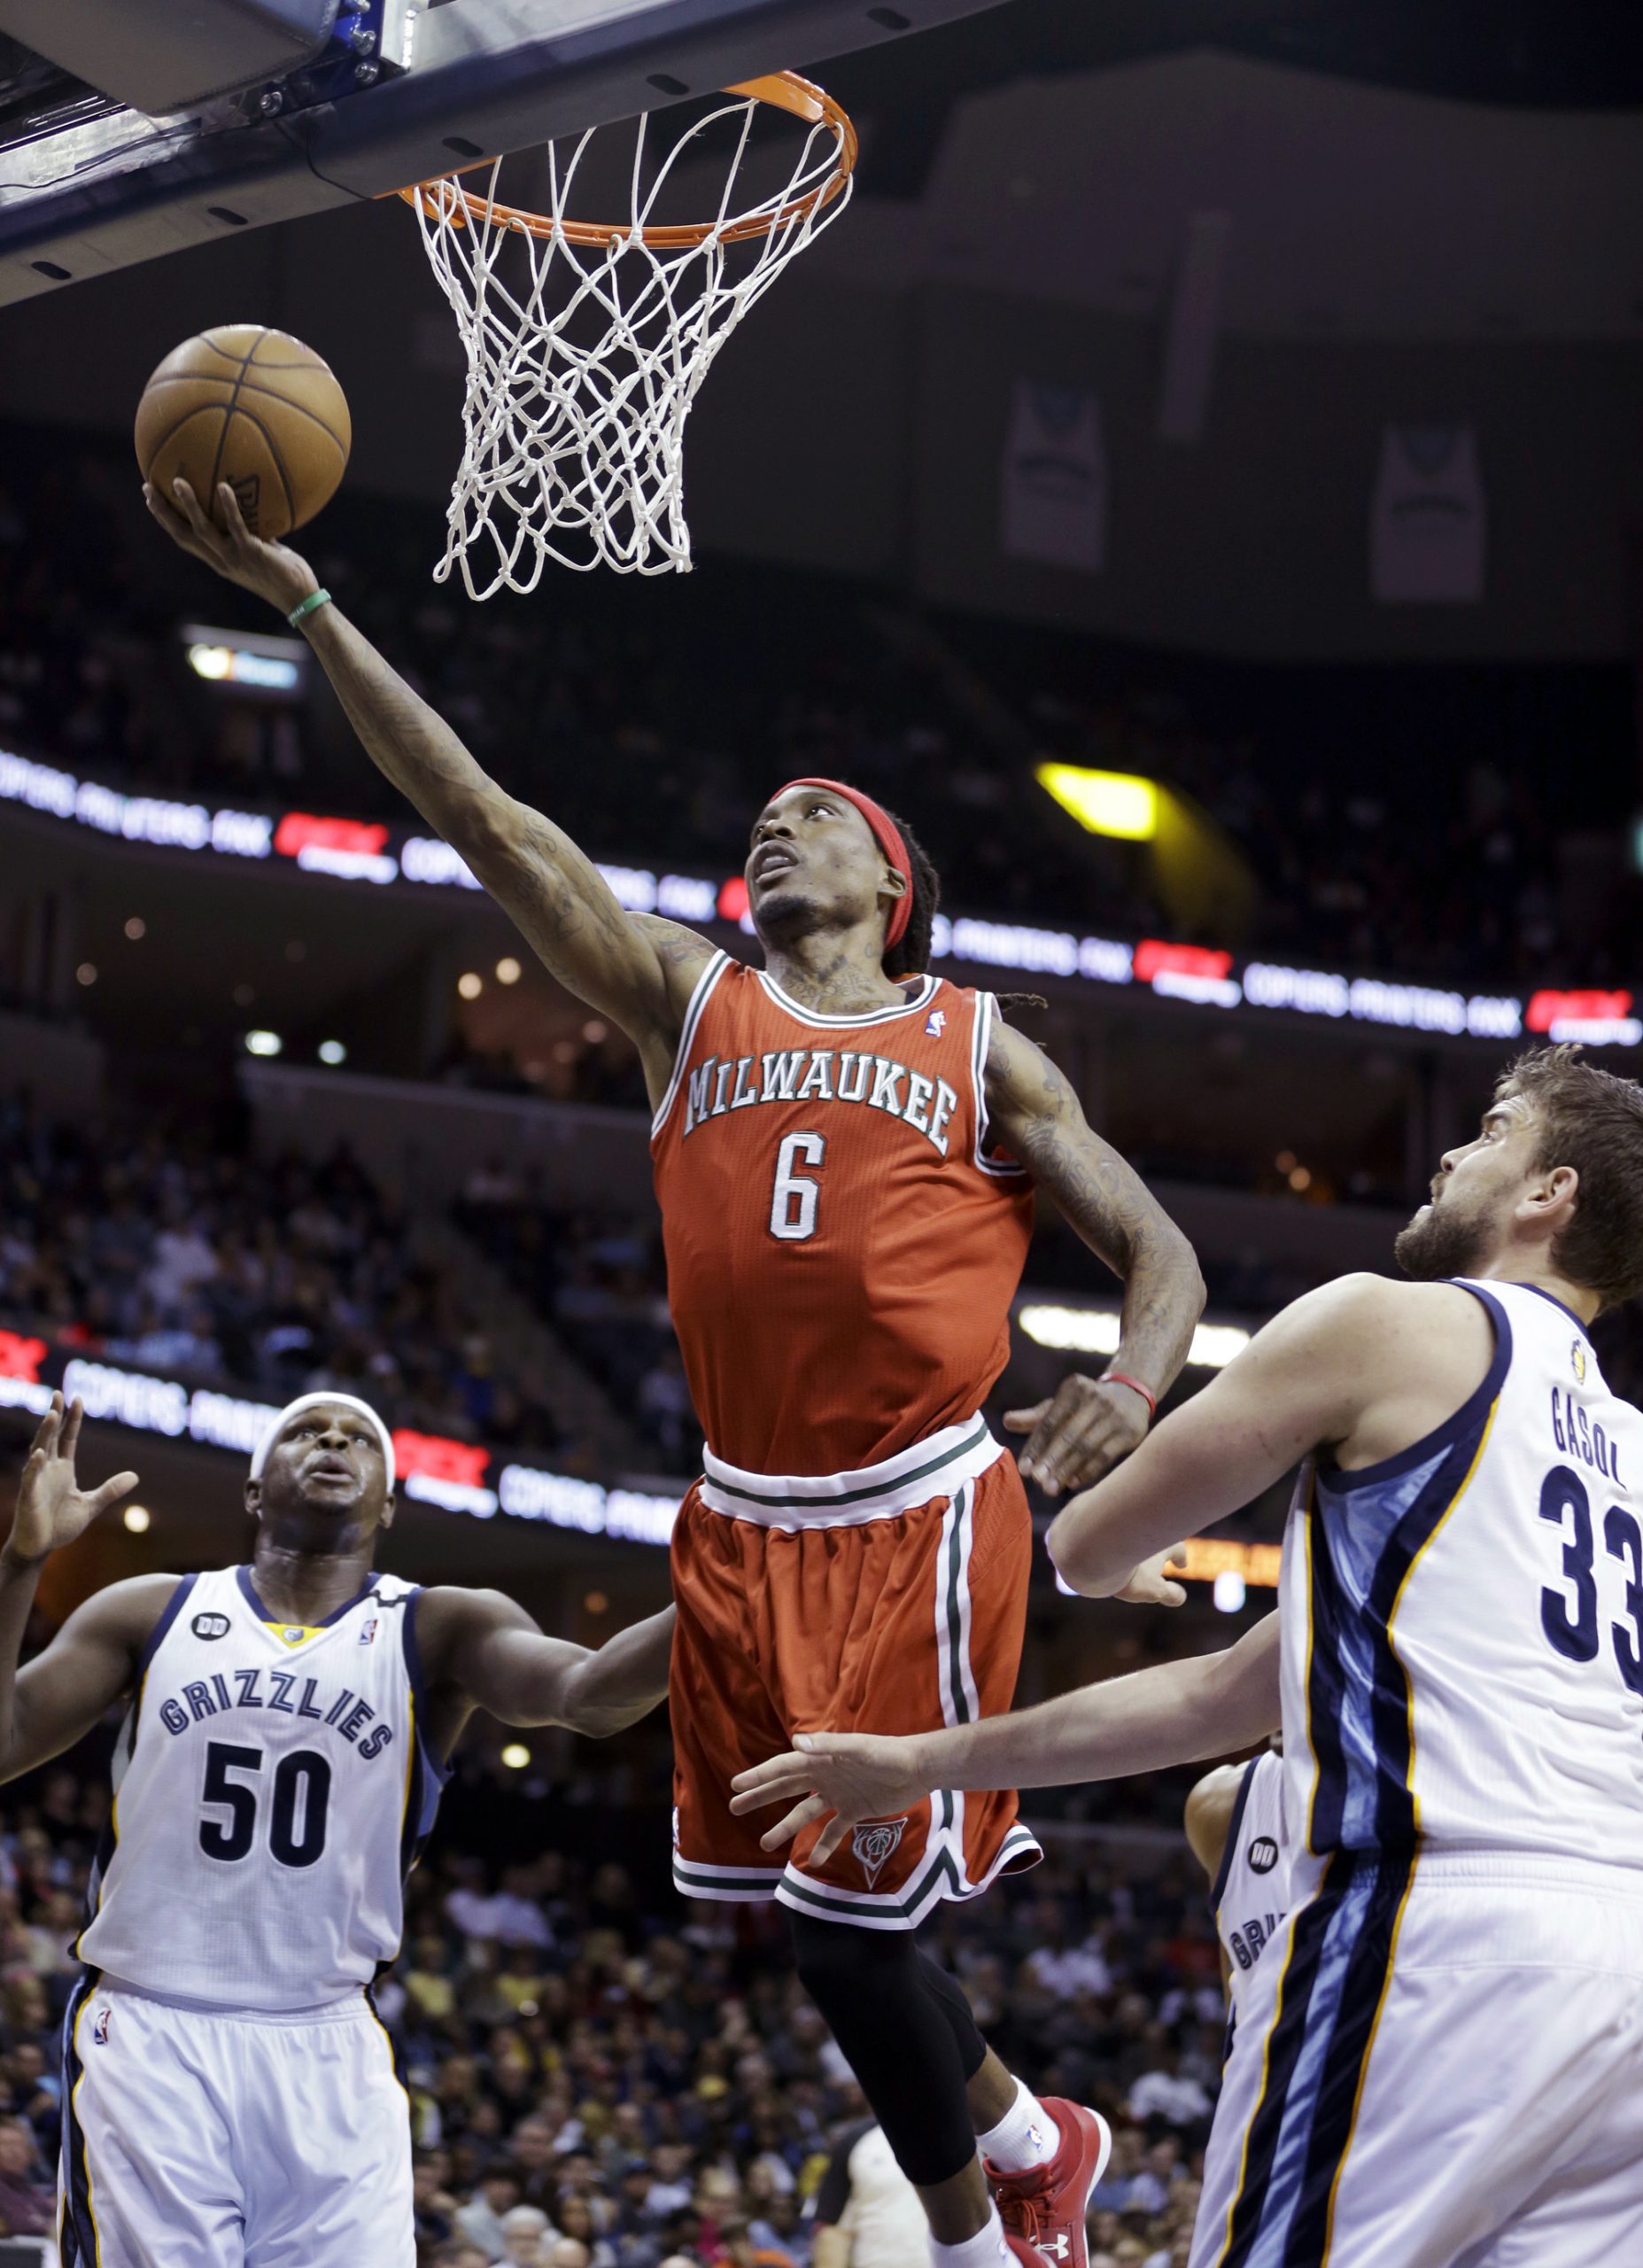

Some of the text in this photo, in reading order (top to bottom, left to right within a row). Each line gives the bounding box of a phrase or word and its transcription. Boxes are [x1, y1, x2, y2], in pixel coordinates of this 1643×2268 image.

[683, 1049, 958, 1159] MILWAUKEE
[769, 1130, 826, 1240] 6
[1552, 1386, 1627, 1491] GASOL
[1538, 1464, 1643, 1697] 33
[159, 1669, 393, 1760] GRIZZLIES
[199, 1741, 332, 1868] 50
[1228, 1913, 1287, 1971] GRI
